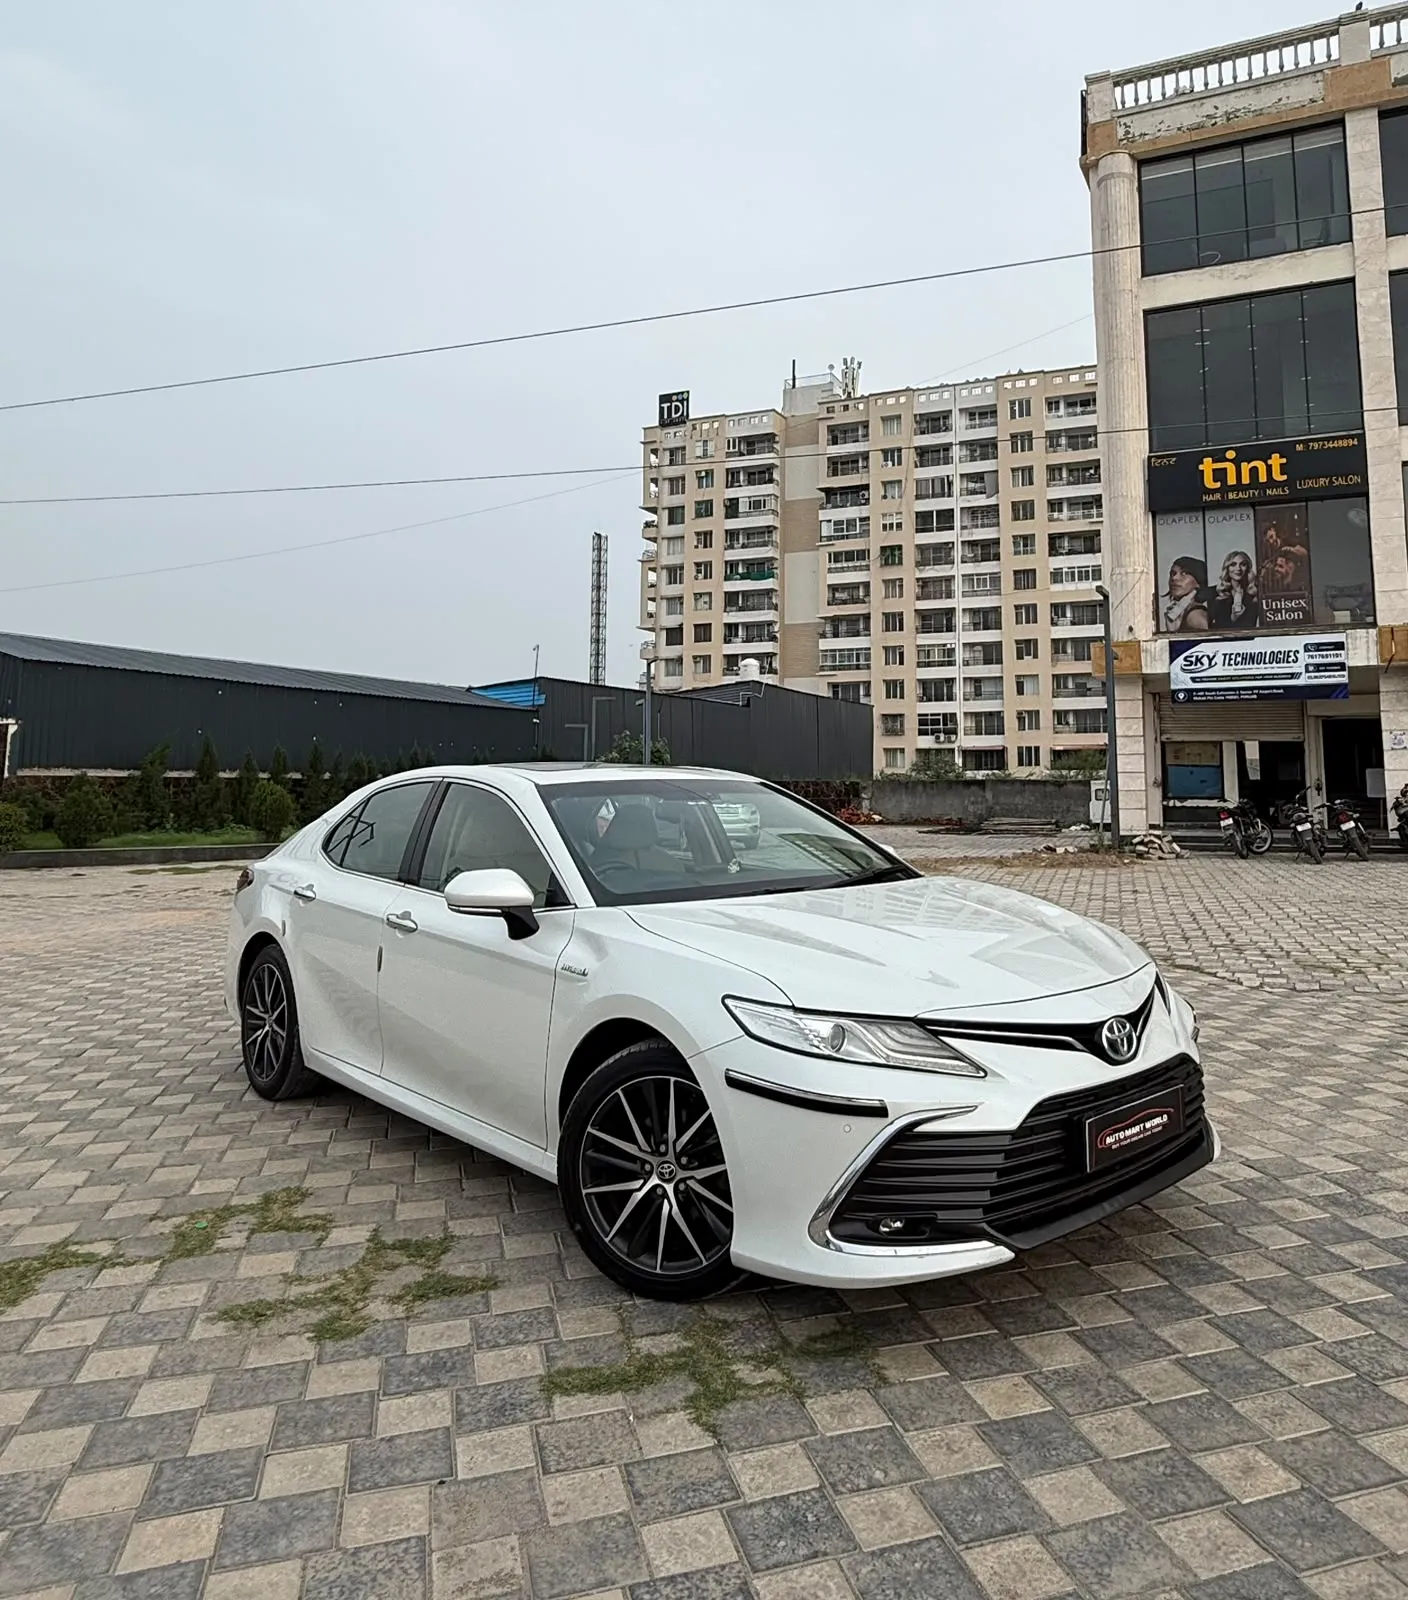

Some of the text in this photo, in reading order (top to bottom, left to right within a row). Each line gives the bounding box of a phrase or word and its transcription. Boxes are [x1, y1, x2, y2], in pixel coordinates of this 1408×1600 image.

[1308, 438, 1358, 450] 7973448894
[1199, 450, 1287, 489] tint
[1296, 474, 1361, 489] LUXURY SALON
[1202, 486, 1289, 502] HAIR BEAUTY NAILS
[1157, 514, 1201, 526] OLAPLEX
[1207, 512, 1252, 525] OLAPLEX
[1262, 598, 1307, 610] Unisex
[1266, 609, 1303, 621] Salon
[1183, 649, 1300, 667] SKY TECHNOLOGIES
[1106, 1132, 1124, 1144] AUTO
[1125, 1123, 1144, 1137] MART
[1145, 1114, 1168, 1129] WORLD
